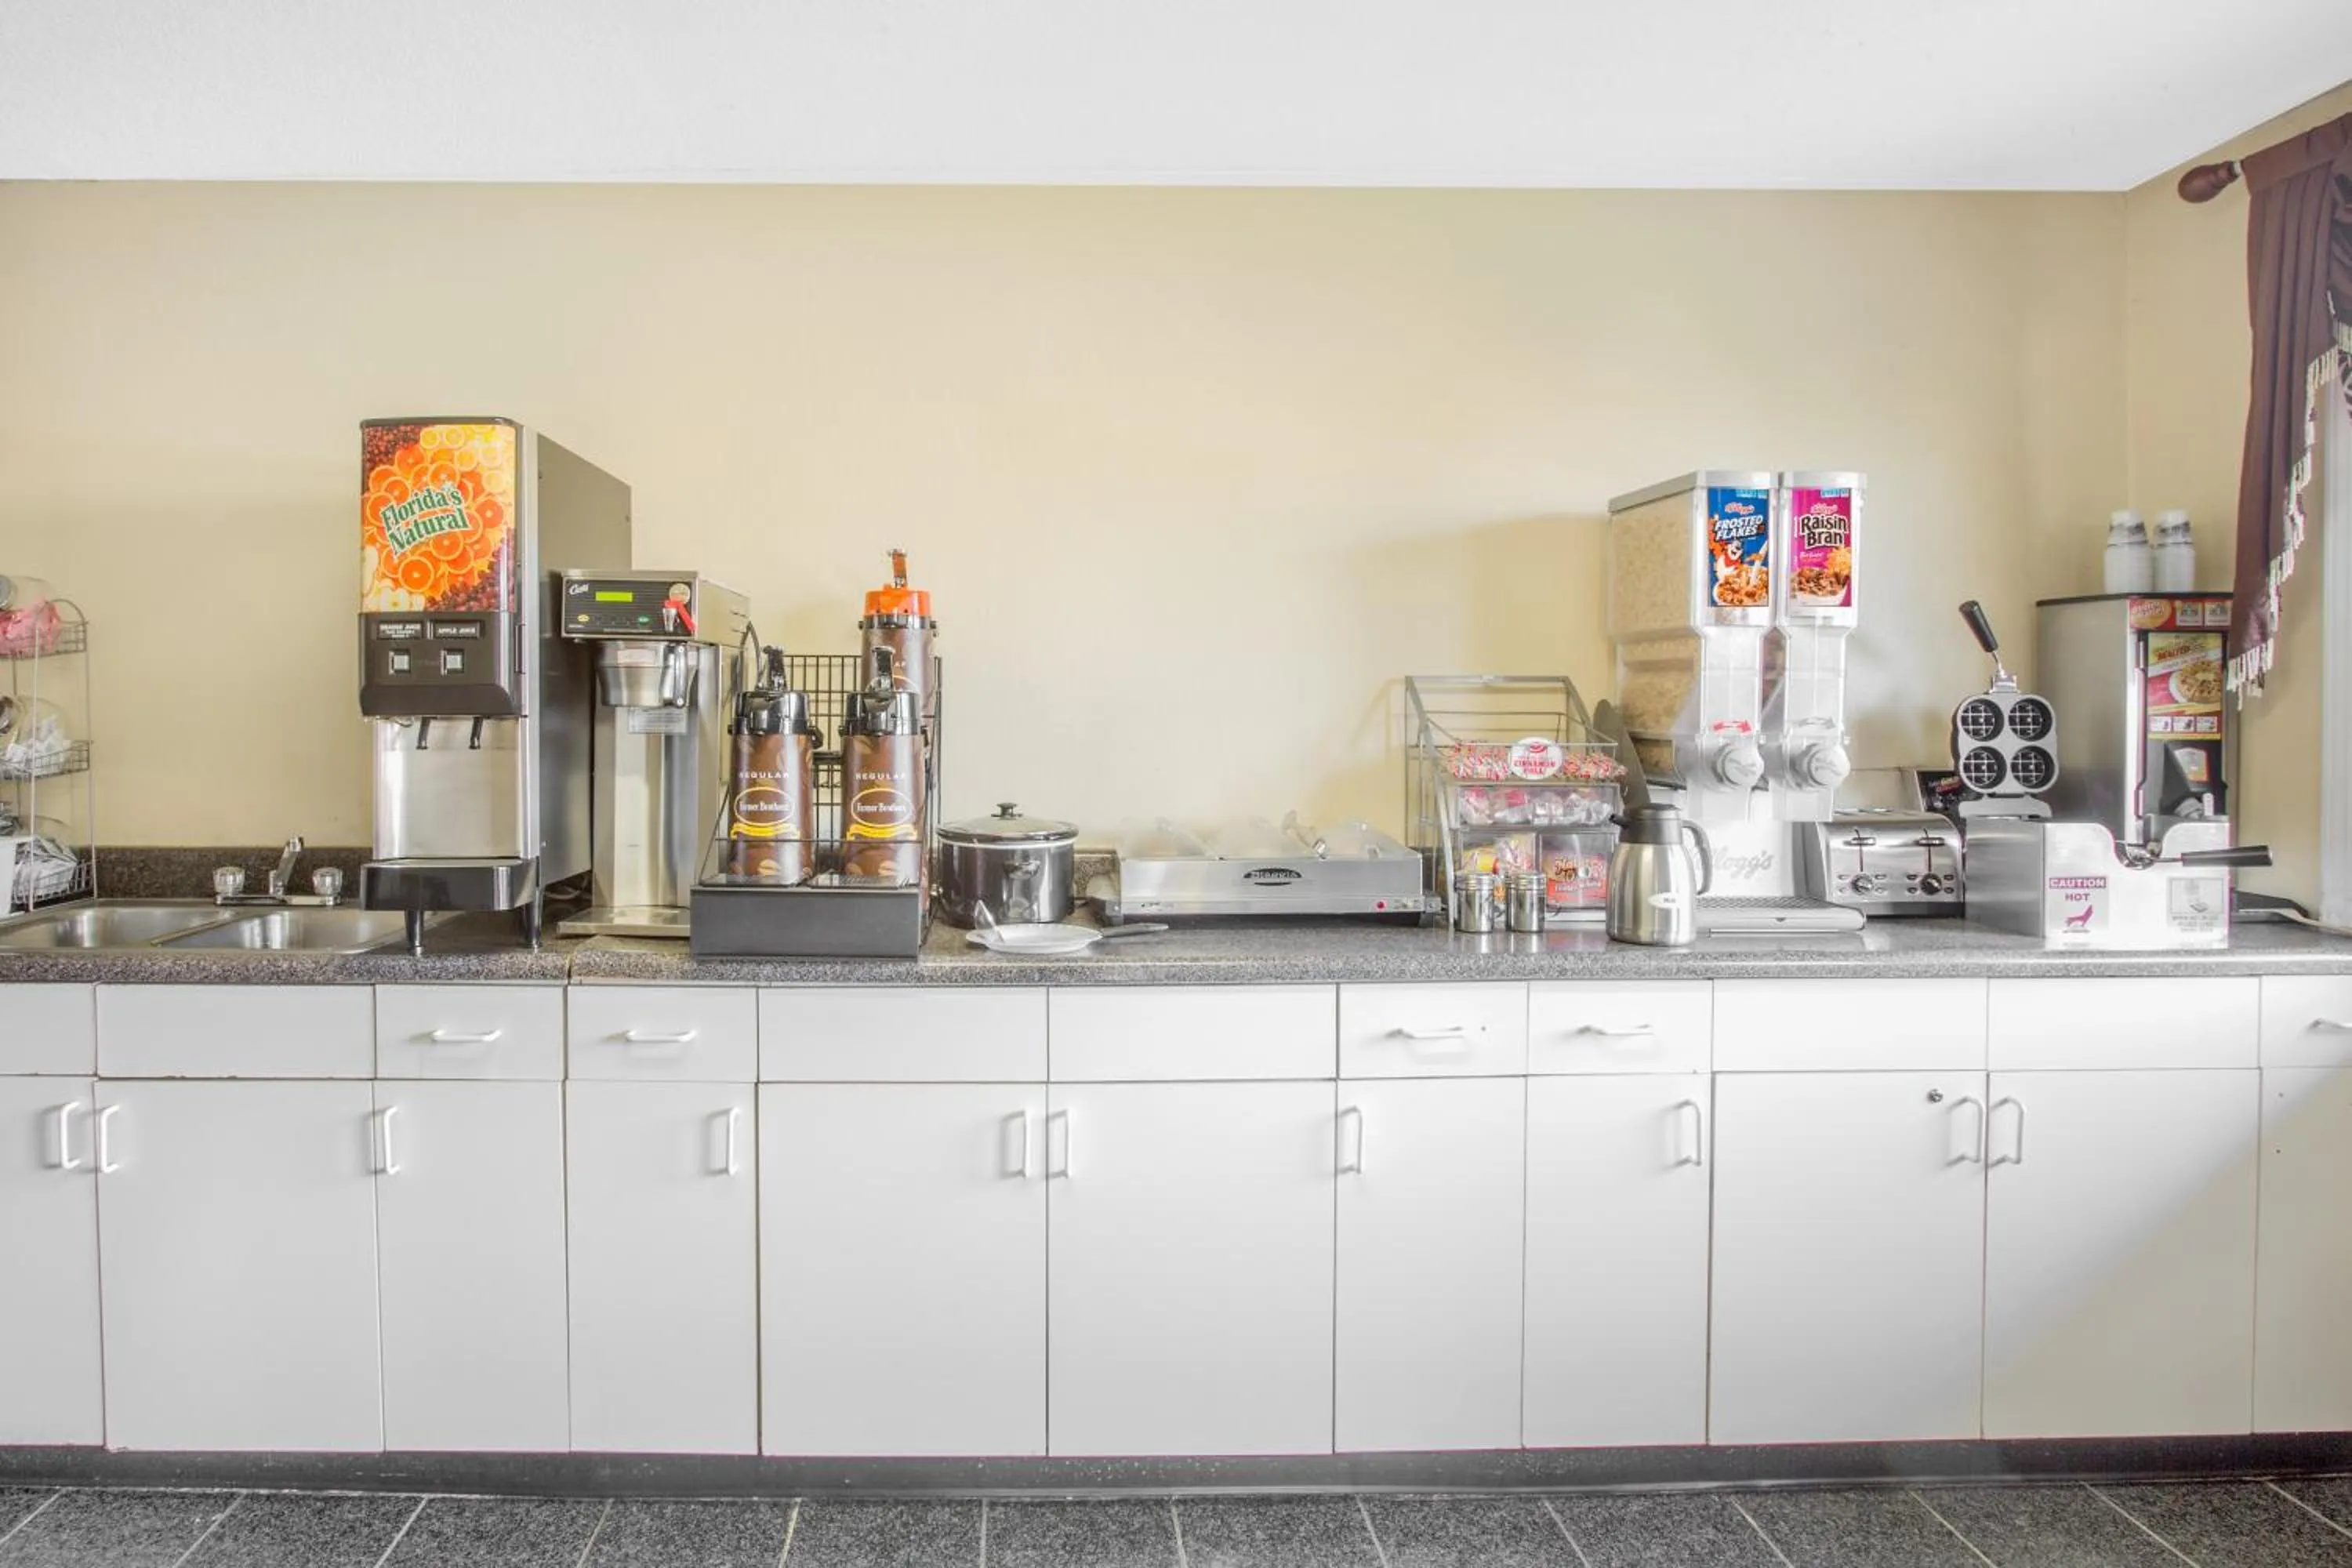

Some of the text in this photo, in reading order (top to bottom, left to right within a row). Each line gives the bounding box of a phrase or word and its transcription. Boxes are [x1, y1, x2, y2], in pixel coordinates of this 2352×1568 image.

[381, 487, 462, 533] Florida's
[388, 507, 470, 555] Natural
[1715, 515, 1763, 532] FROSTED
[1801, 515, 1847, 534] Raisin
[1715, 524, 1758, 541] FLAKES
[1806, 531, 1843, 547] Bran
[2049, 878, 2106, 888] CAUTION
[2064, 892, 2091, 902] HOT
